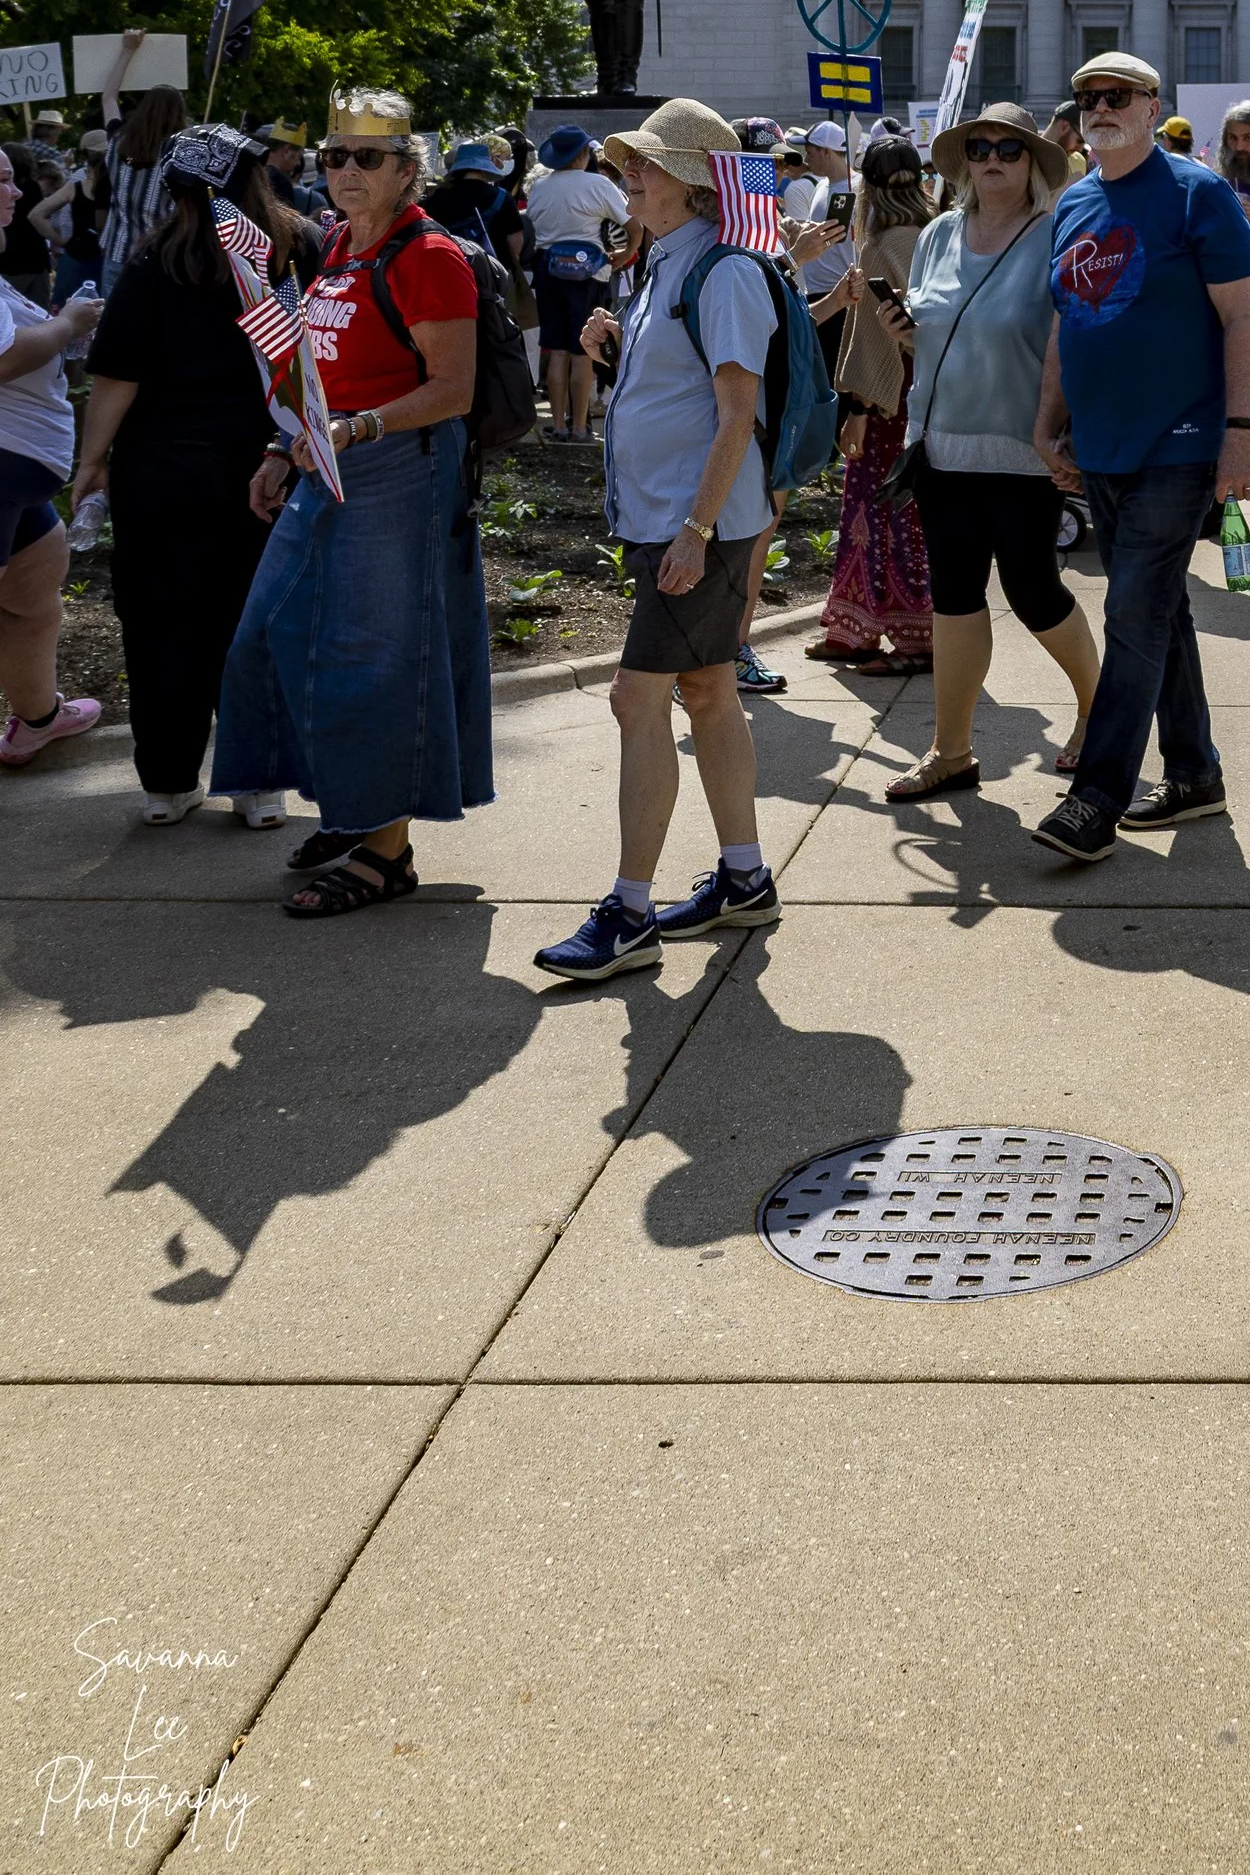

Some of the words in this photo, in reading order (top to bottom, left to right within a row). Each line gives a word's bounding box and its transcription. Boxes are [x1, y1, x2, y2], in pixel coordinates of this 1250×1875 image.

[953, 1173, 1055, 1184] NEENAH
[830, 1230, 861, 1242] CO
[868, 1231, 980, 1244] FOUNDRY
[992, 1232, 1092, 1245] NEENAH
